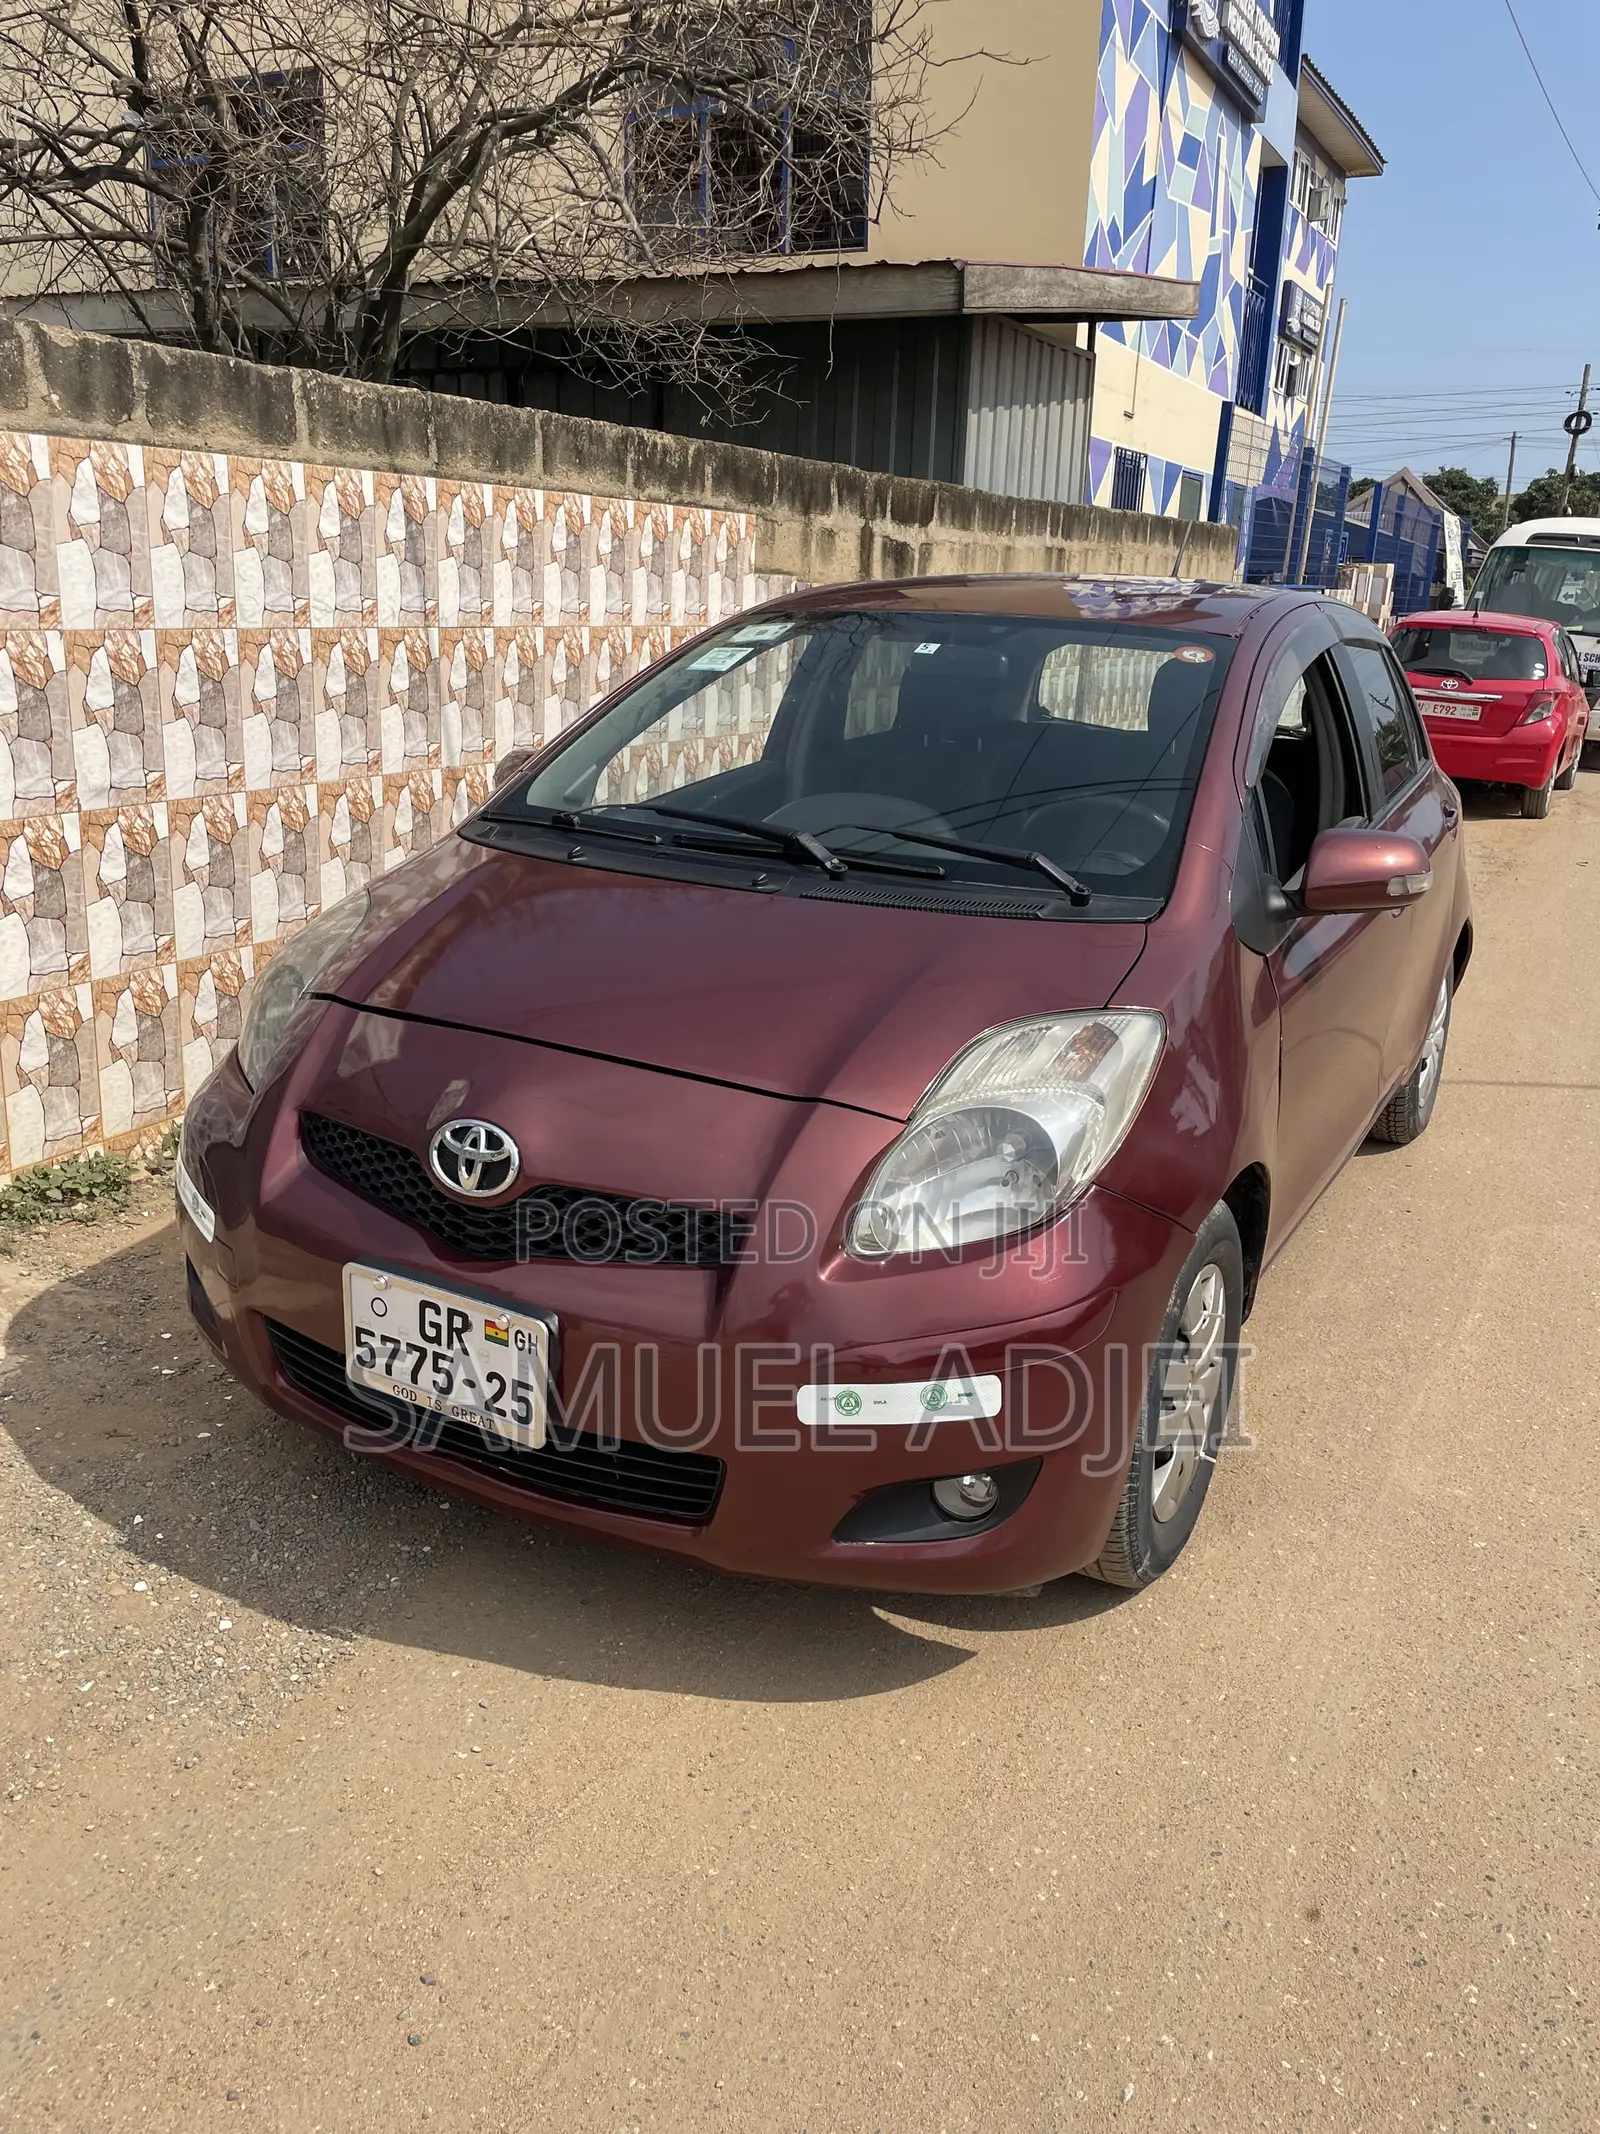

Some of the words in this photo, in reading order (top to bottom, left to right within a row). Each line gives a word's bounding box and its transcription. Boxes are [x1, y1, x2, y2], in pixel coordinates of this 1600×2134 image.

[1433, 704, 1457, 716] E792
[419, 1300, 469, 1356] GR
[514, 1330, 538, 1356] GH
[355, 1326, 533, 1425] 5775-25
[392, 1384, 417, 1402] GOD
[427, 1396, 443, 1411] IS
[451, 1406, 494, 1430] GREAT
